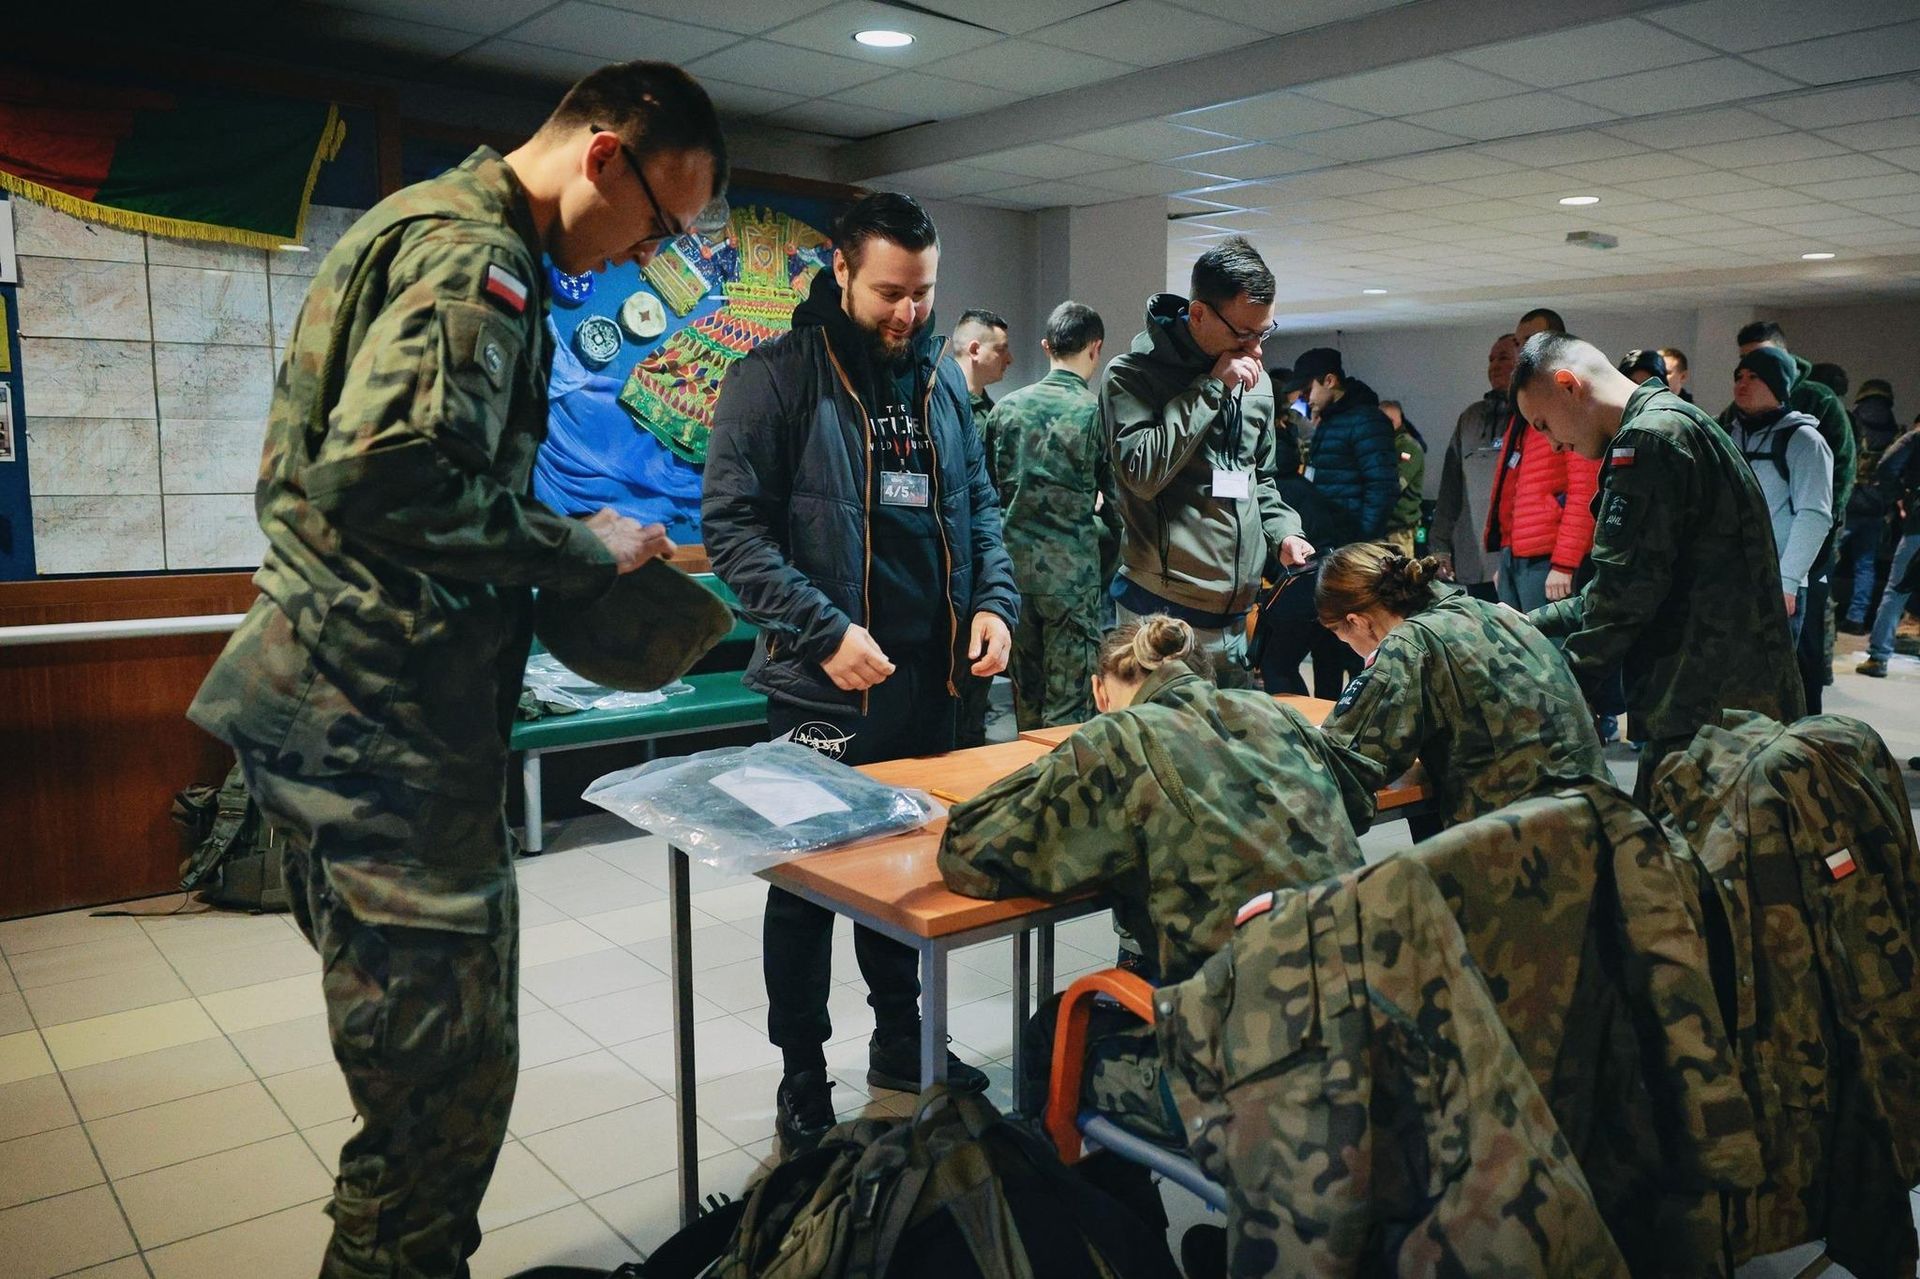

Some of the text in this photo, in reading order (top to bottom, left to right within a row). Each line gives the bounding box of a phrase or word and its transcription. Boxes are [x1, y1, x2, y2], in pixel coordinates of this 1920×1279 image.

[885, 404, 906, 414] TE
[870, 415, 922, 438] ITCHE
[869, 442, 893, 451] WLD
[800, 732, 841, 753] NASA
